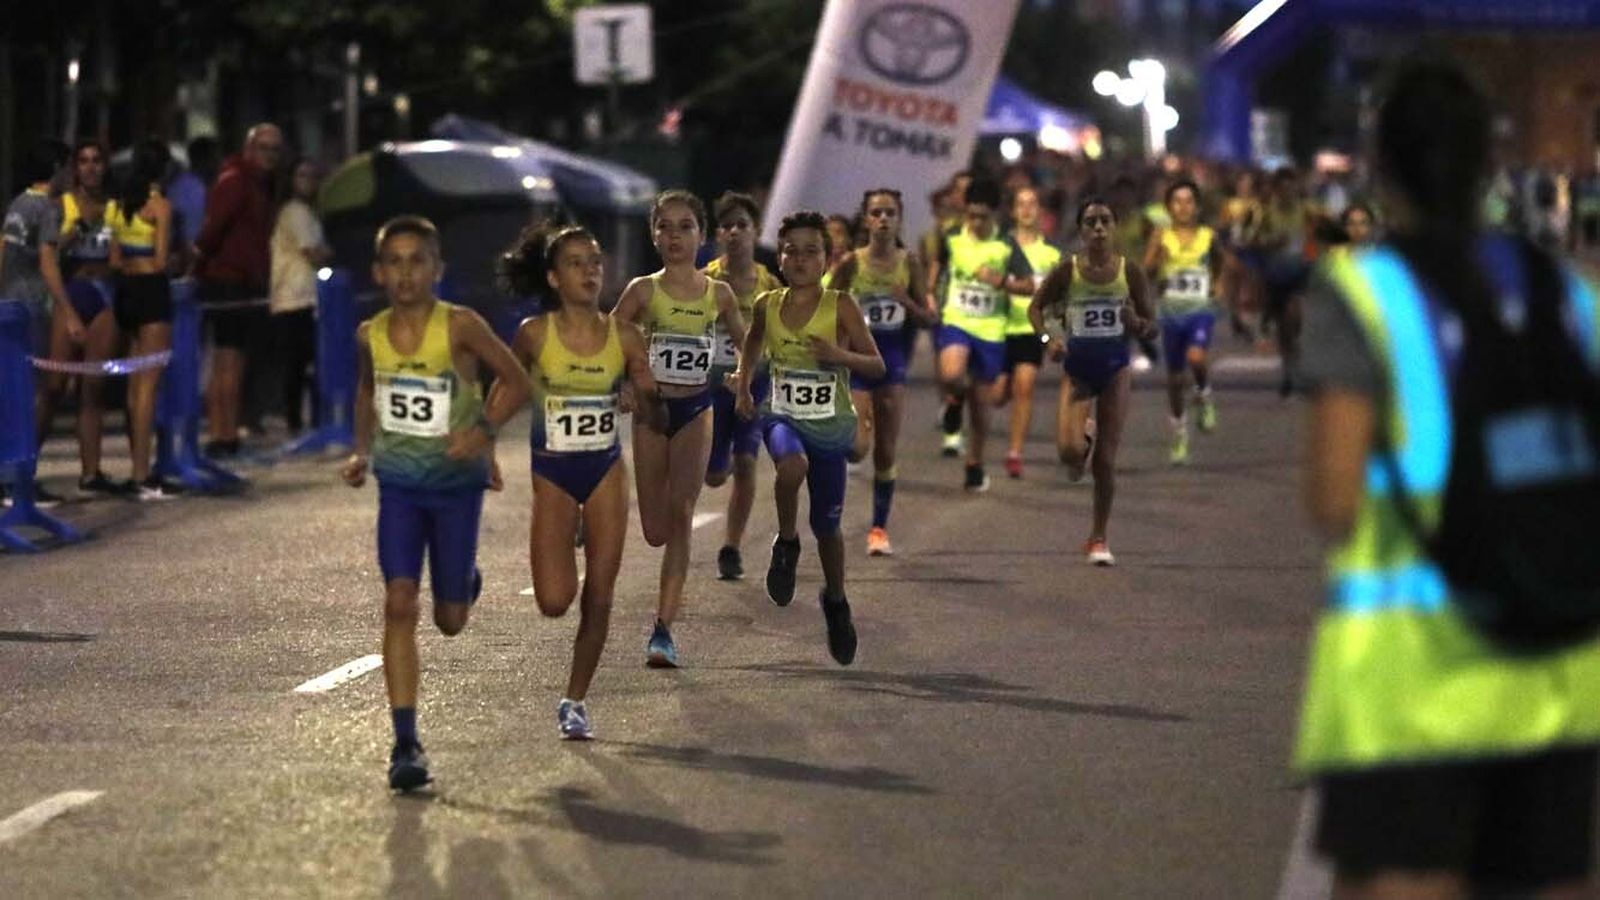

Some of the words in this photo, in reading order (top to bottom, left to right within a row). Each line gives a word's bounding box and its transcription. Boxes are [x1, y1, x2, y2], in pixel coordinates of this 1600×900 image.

[832, 78, 958, 126] TOYOTA
[1084, 309, 1116, 328] 29
[658, 349, 709, 371] 124
[780, 383, 832, 406] 138
[390, 393, 433, 422] 53
[556, 411, 615, 436] 128
